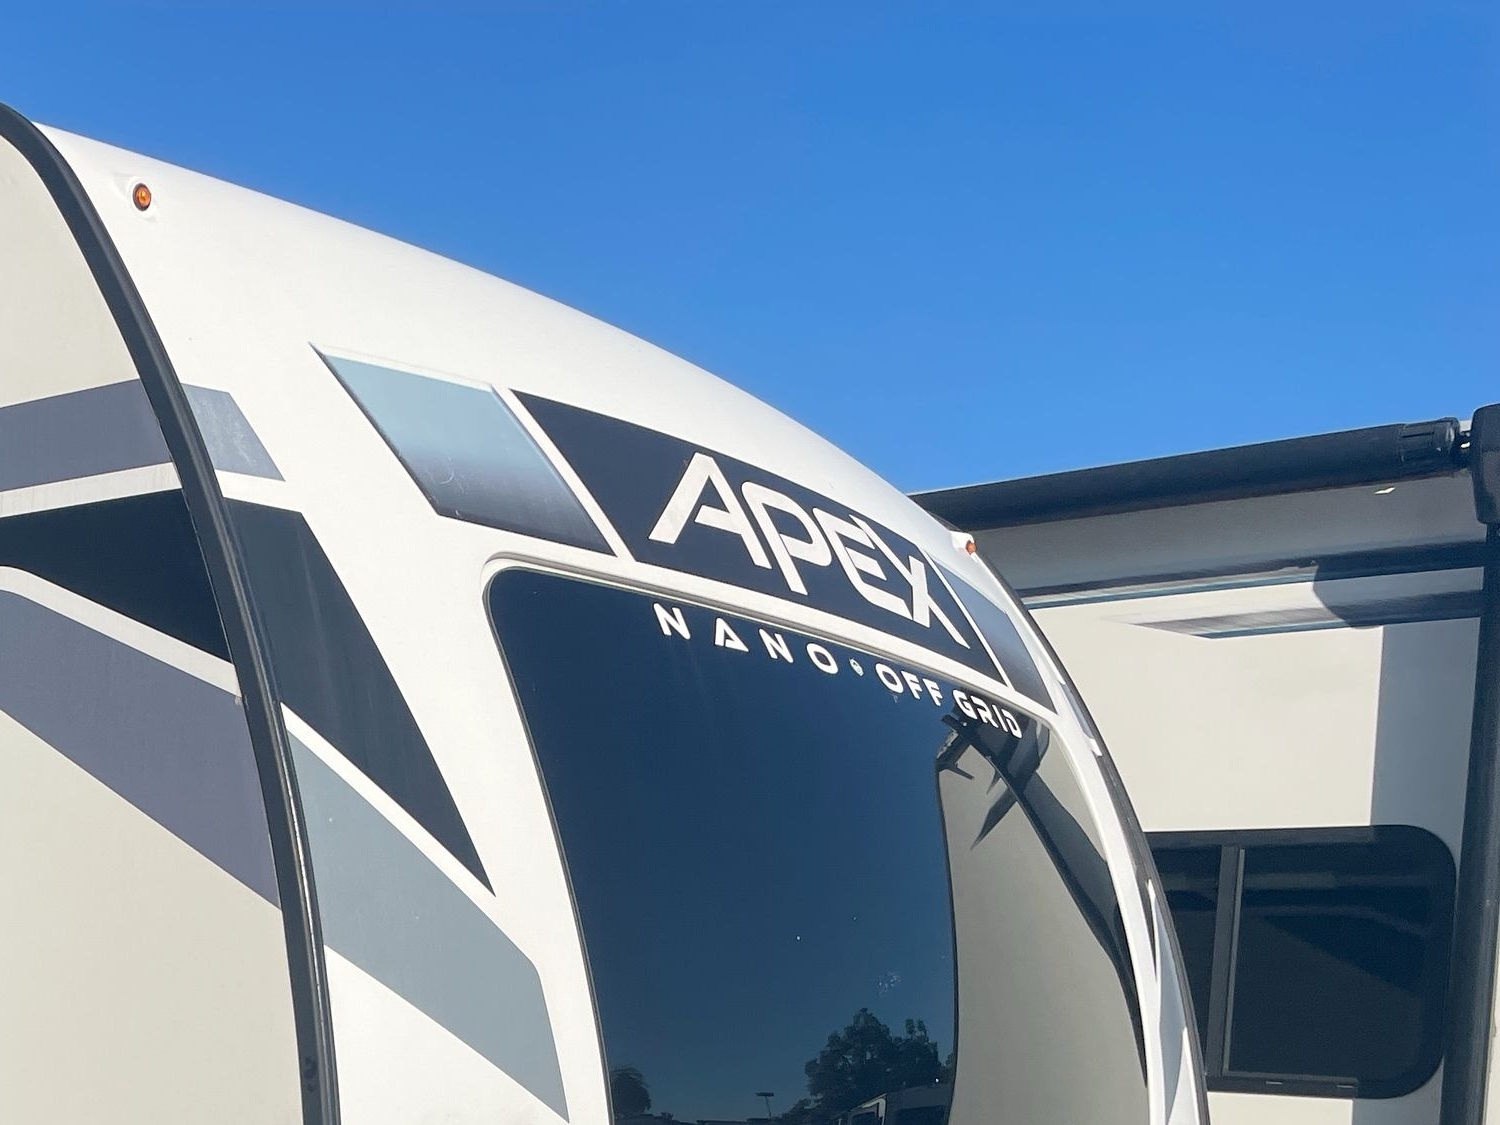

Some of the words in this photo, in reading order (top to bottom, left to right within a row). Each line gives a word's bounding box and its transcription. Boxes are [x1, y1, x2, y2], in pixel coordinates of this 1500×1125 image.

[648, 451, 970, 649] APEX
[653, 602, 839, 675] NANO
[875, 663, 944, 707] OFF
[952, 689, 1023, 739] GRID
